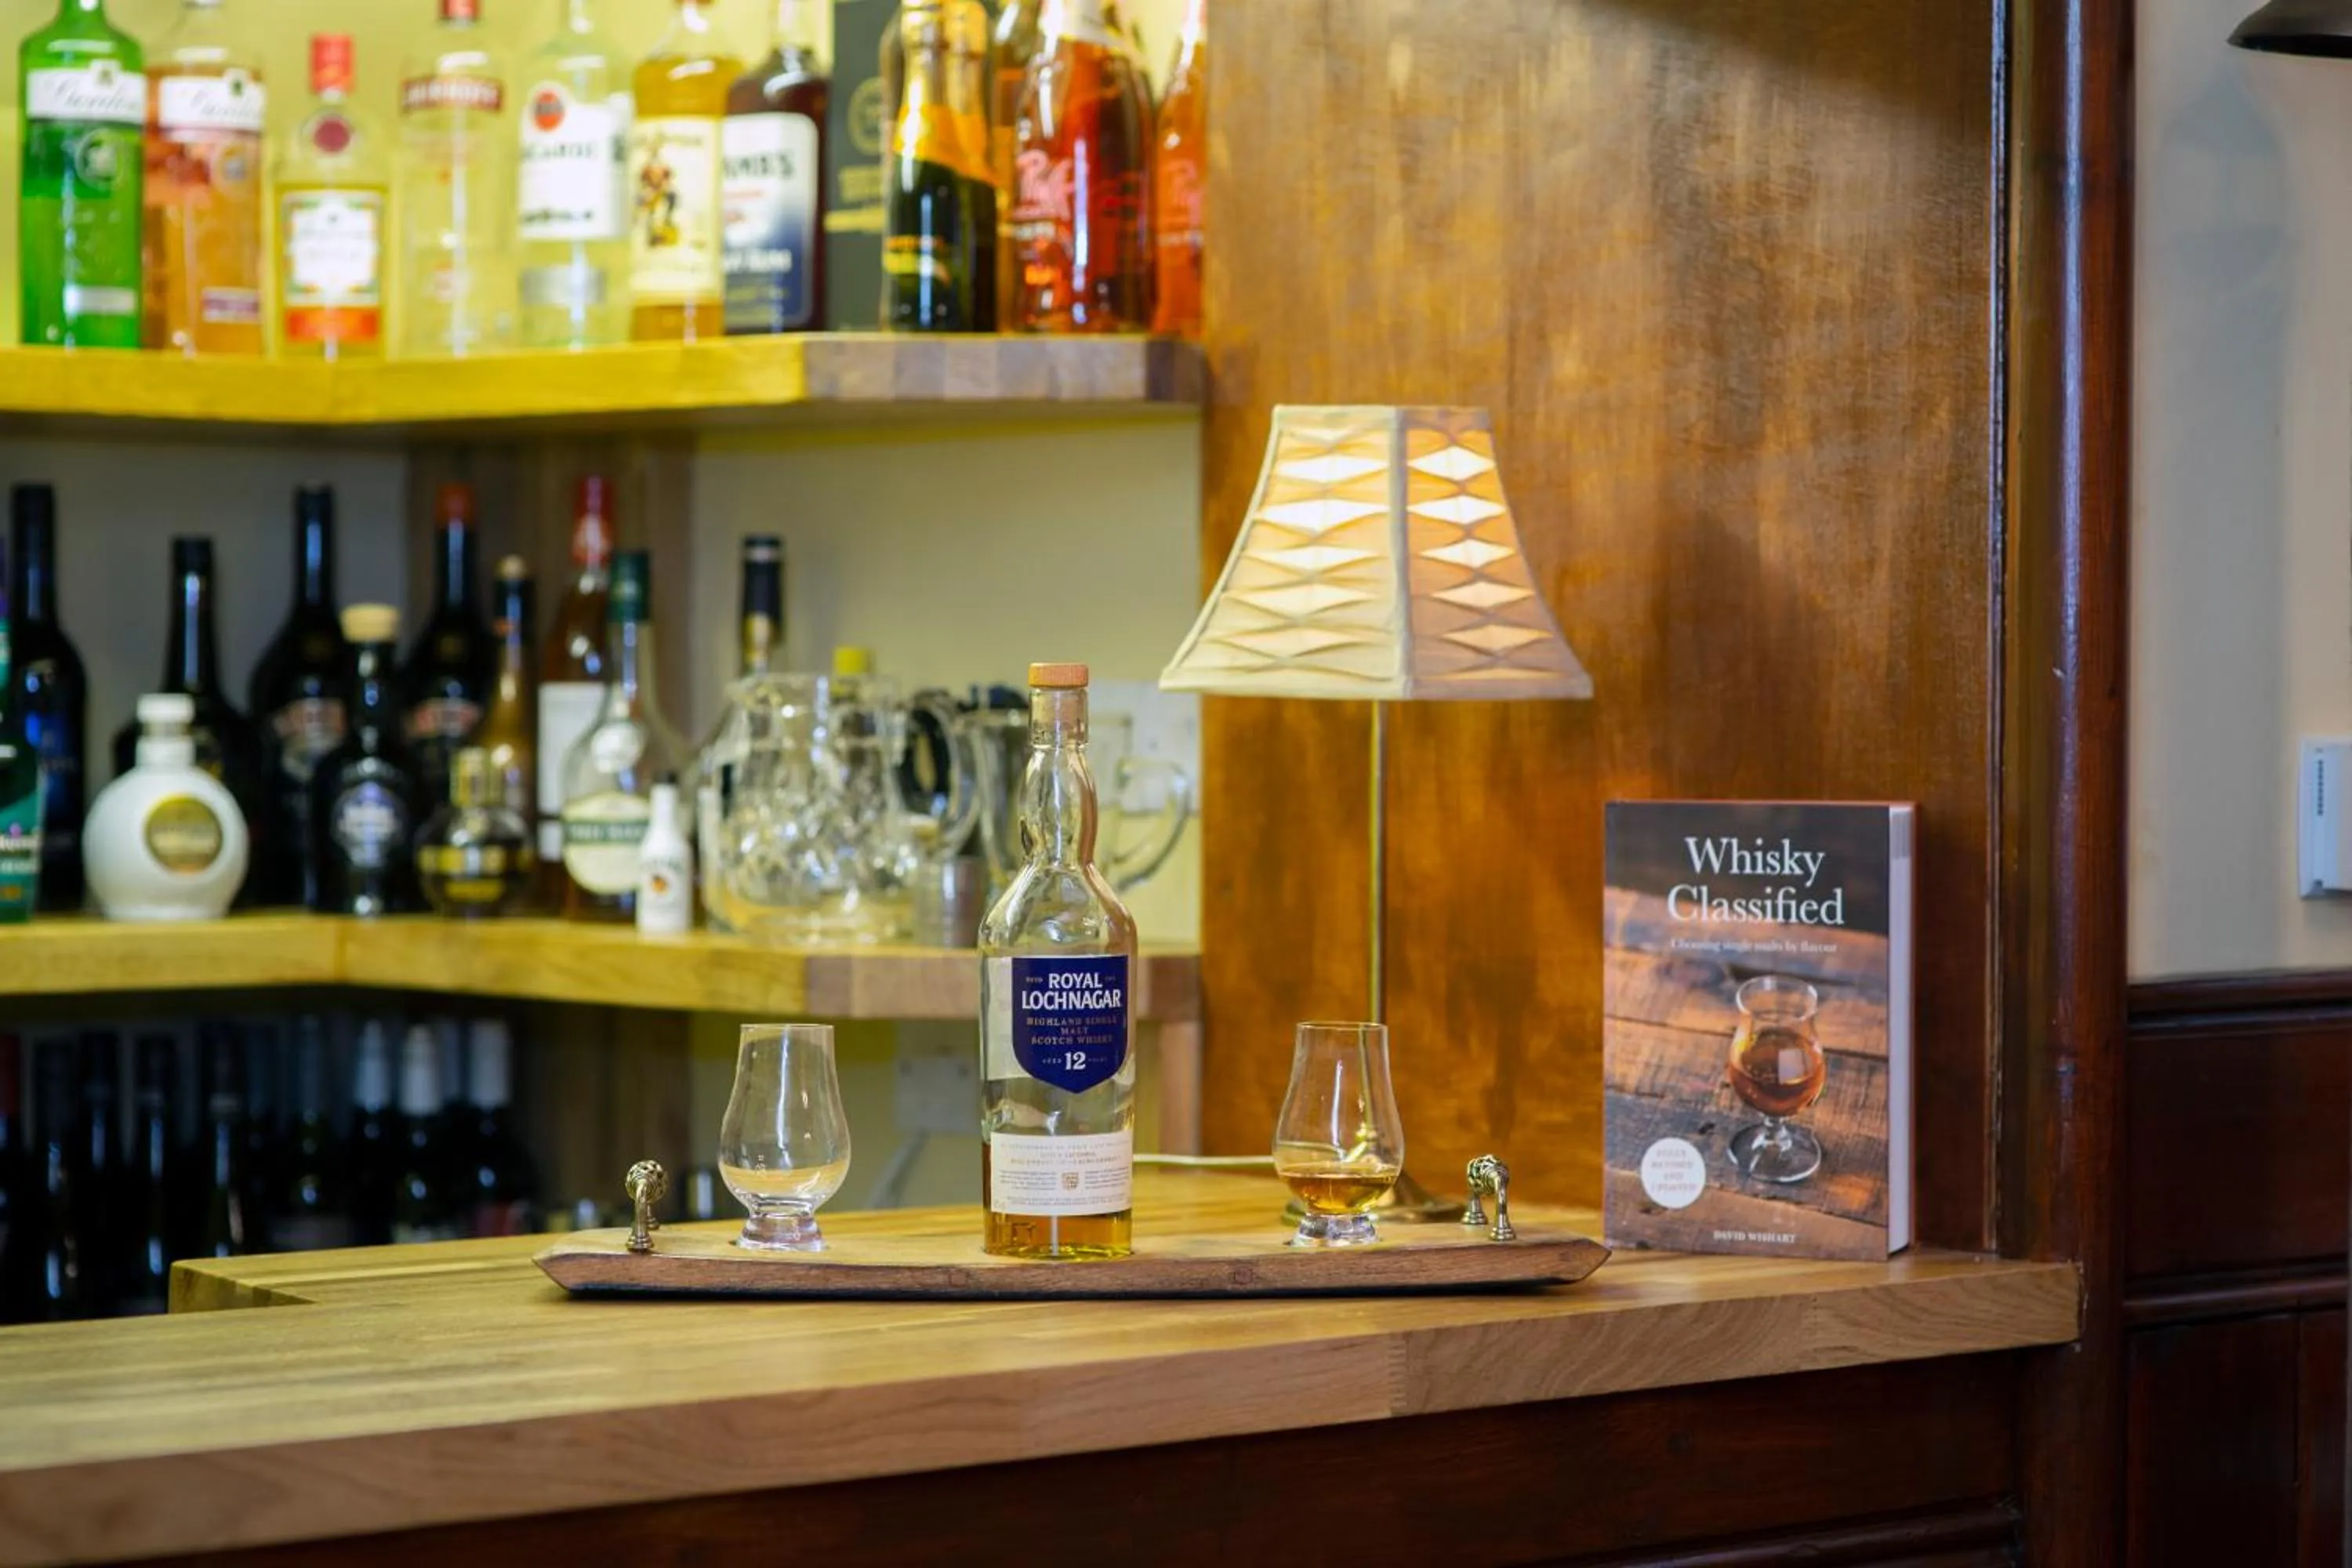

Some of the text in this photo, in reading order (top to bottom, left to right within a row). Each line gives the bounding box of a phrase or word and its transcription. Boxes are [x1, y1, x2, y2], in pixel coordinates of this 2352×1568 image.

[1684, 836, 1825, 888] Whisky
[1668, 884, 1845, 925] Classified
[1048, 972, 1103, 989] ROYAL
[1022, 989, 1122, 1011] LOCHNAGAR
[1026, 1017, 1082, 1026] HIGHLAND
[1061, 1026, 1089, 1035] MALT
[1031, 1036, 1074, 1045] SCOTCH
[1065, 1051, 1087, 1070] 12
[1713, 1229, 1795, 1243] DAVID WISHART
